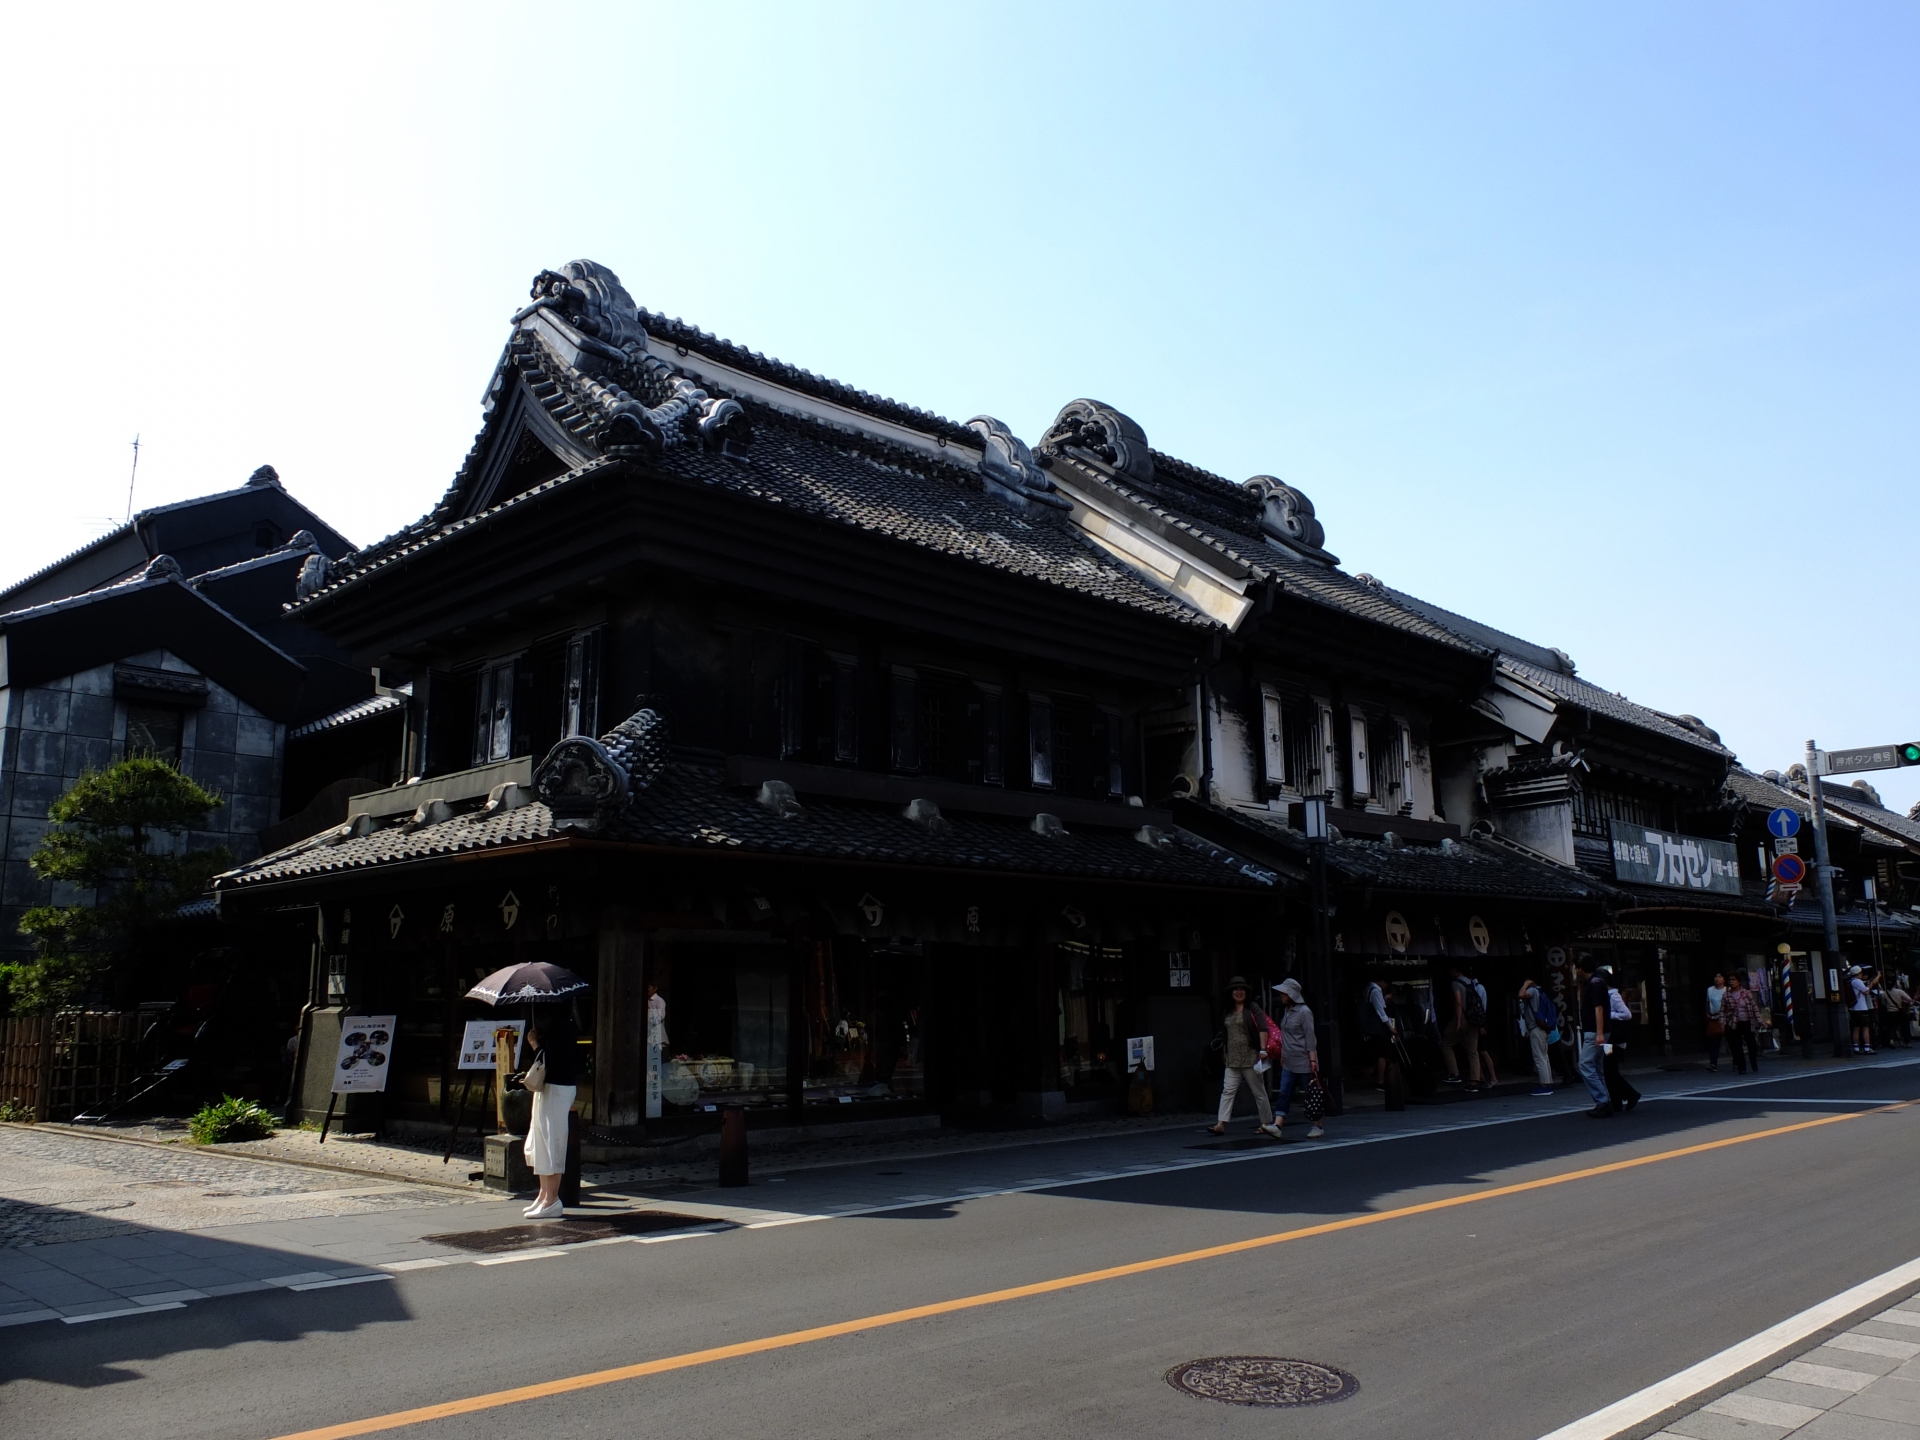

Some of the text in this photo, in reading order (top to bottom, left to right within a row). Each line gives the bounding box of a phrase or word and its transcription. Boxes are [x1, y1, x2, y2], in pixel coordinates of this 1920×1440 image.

[1835, 751, 1892, 767] 押ボタン信号
[440, 902, 456, 933] 原
[966, 905, 981, 933] 原
